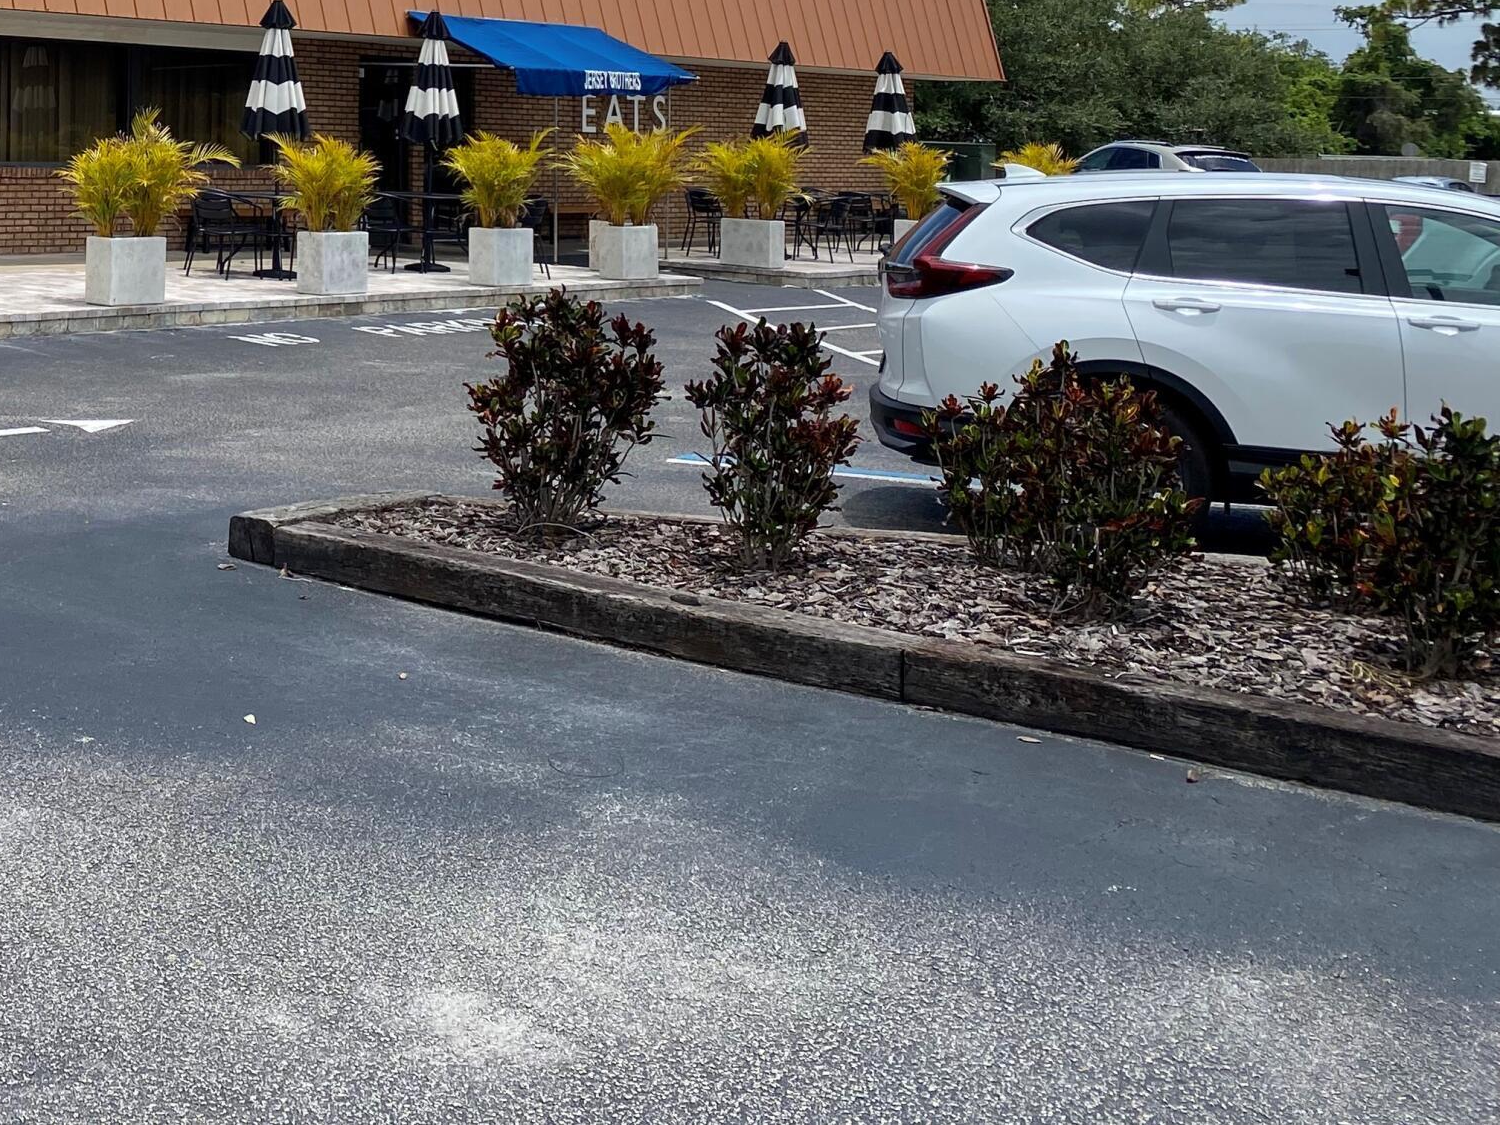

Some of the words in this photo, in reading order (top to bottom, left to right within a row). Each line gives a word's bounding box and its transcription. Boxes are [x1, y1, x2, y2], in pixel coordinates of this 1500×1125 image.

[584, 70, 608, 90] JERSEY
[608, 71, 641, 91] BROTHERS
[582, 94, 667, 135] EATS
[227, 332, 320, 347] NO
